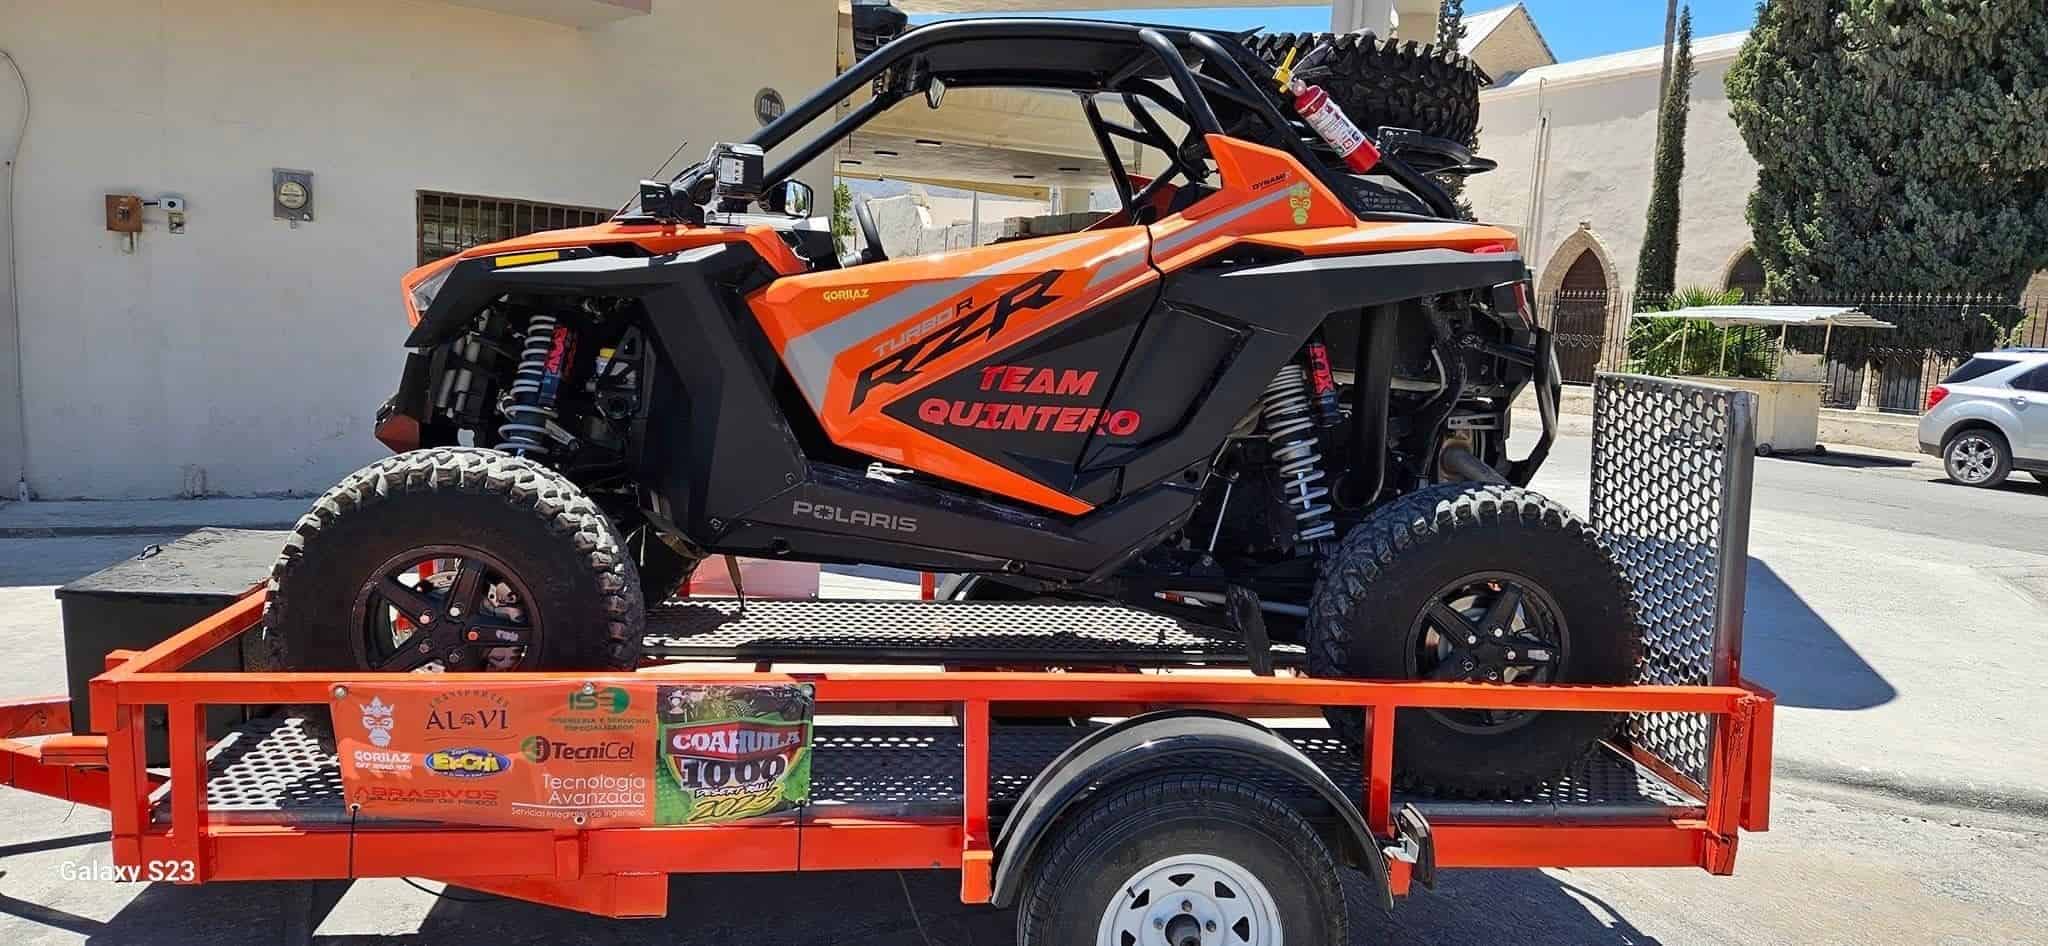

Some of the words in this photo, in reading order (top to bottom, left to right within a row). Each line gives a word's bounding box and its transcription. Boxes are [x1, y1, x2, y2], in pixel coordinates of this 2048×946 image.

[849, 269, 1064, 413] RZR
[872, 306, 953, 356] TURBO
[956, 296, 974, 317] R
[979, 365, 1098, 396] TEAM
[918, 398, 1141, 436] QUINTERO
[792, 501, 917, 532] POLARIS
[552, 741, 634, 759] TecniCel
[672, 730, 800, 754] COAHUILA
[682, 755, 788, 789] 1000
[357, 786, 497, 800] ABRASIVOS
[548, 789, 645, 804] Avanzada
[688, 787, 780, 821] 2025
[695, 785, 742, 798] DESERT
